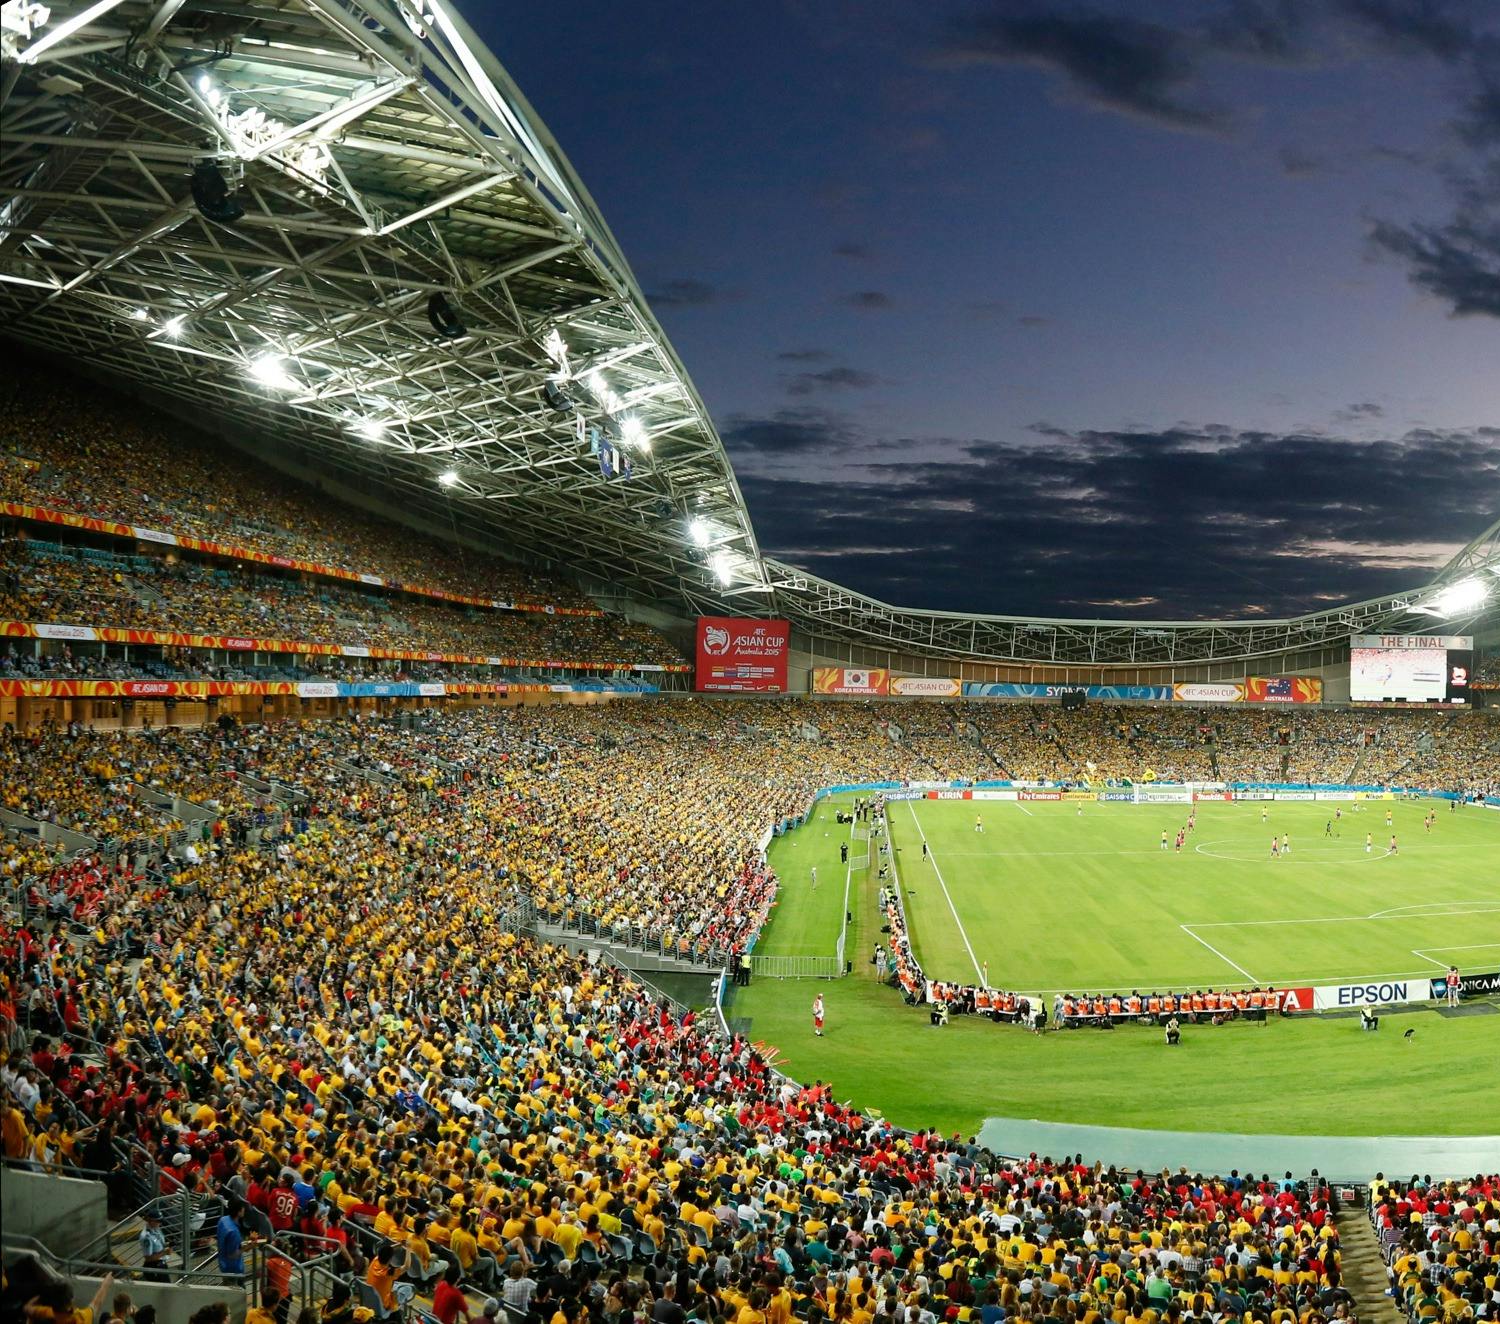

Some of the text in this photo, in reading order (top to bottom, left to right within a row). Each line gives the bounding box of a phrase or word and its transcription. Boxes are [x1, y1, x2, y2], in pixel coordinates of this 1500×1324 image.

[753, 628, 766, 636] AFC
[732, 636, 784, 647] ASIAN CUP
[1380, 636, 1444, 648] THE FINAL
[734, 647, 780, 656] Australia 2015
[1184, 688, 1196, 696] AFC
[938, 791, 963, 800] KIRIN
[1020, 792, 1032, 800] Fly
[1457, 979, 1490, 992] ONICA
[1338, 983, 1407, 1004] EPSON
[276, 1196, 294, 1216] 96
